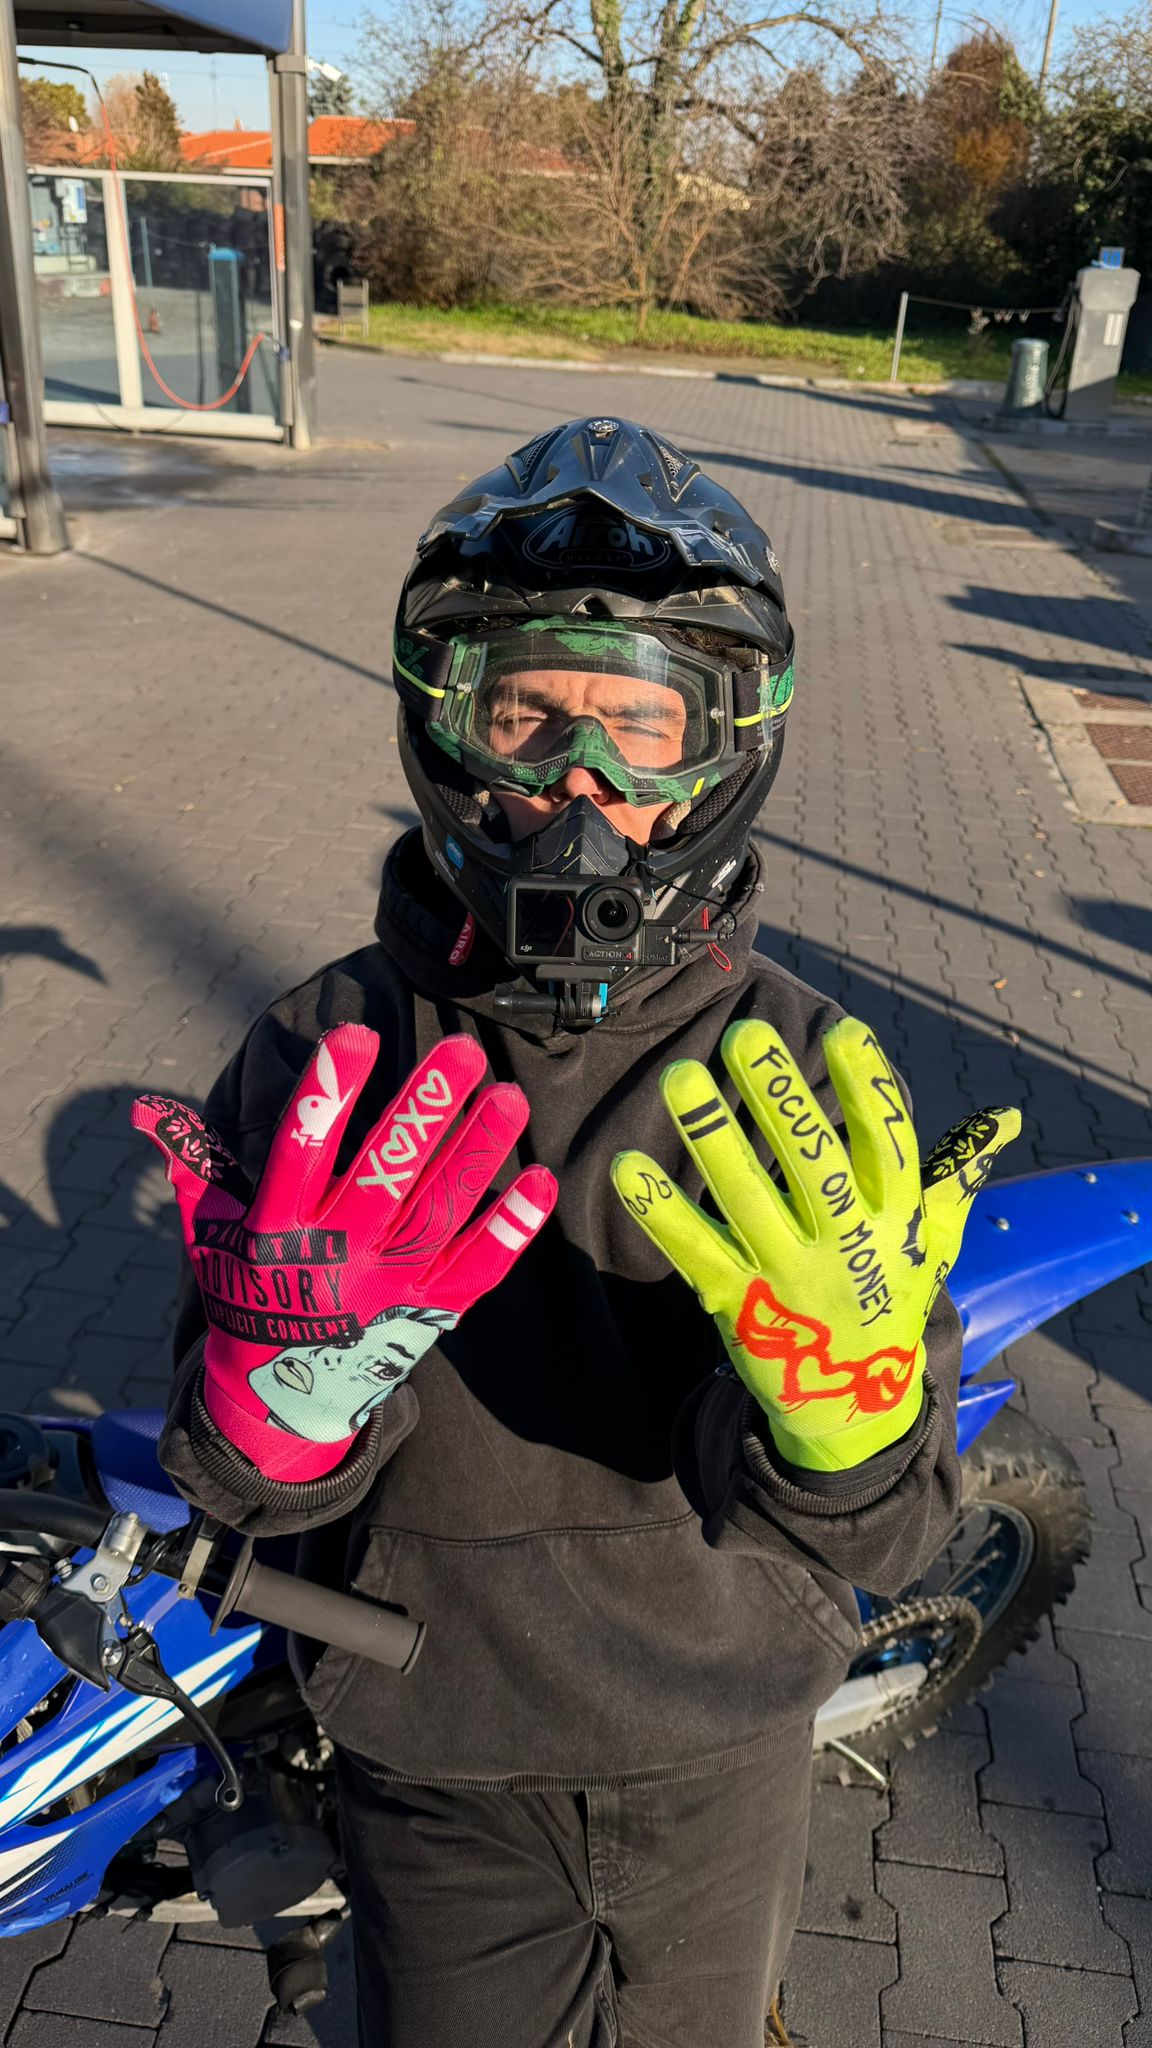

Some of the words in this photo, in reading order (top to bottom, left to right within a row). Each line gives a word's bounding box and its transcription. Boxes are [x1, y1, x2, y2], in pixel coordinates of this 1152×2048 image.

[588, 950, 622, 959] ACTION
[624, 951, 633, 960] 4
[750, 1045, 833, 1161] FOCUS
[821, 1171, 856, 1218] ON
[839, 1219, 893, 1326] MONEY
[200, 1250, 343, 1314] ADVISORY
[267, 1318, 349, 1341] CONTENT
